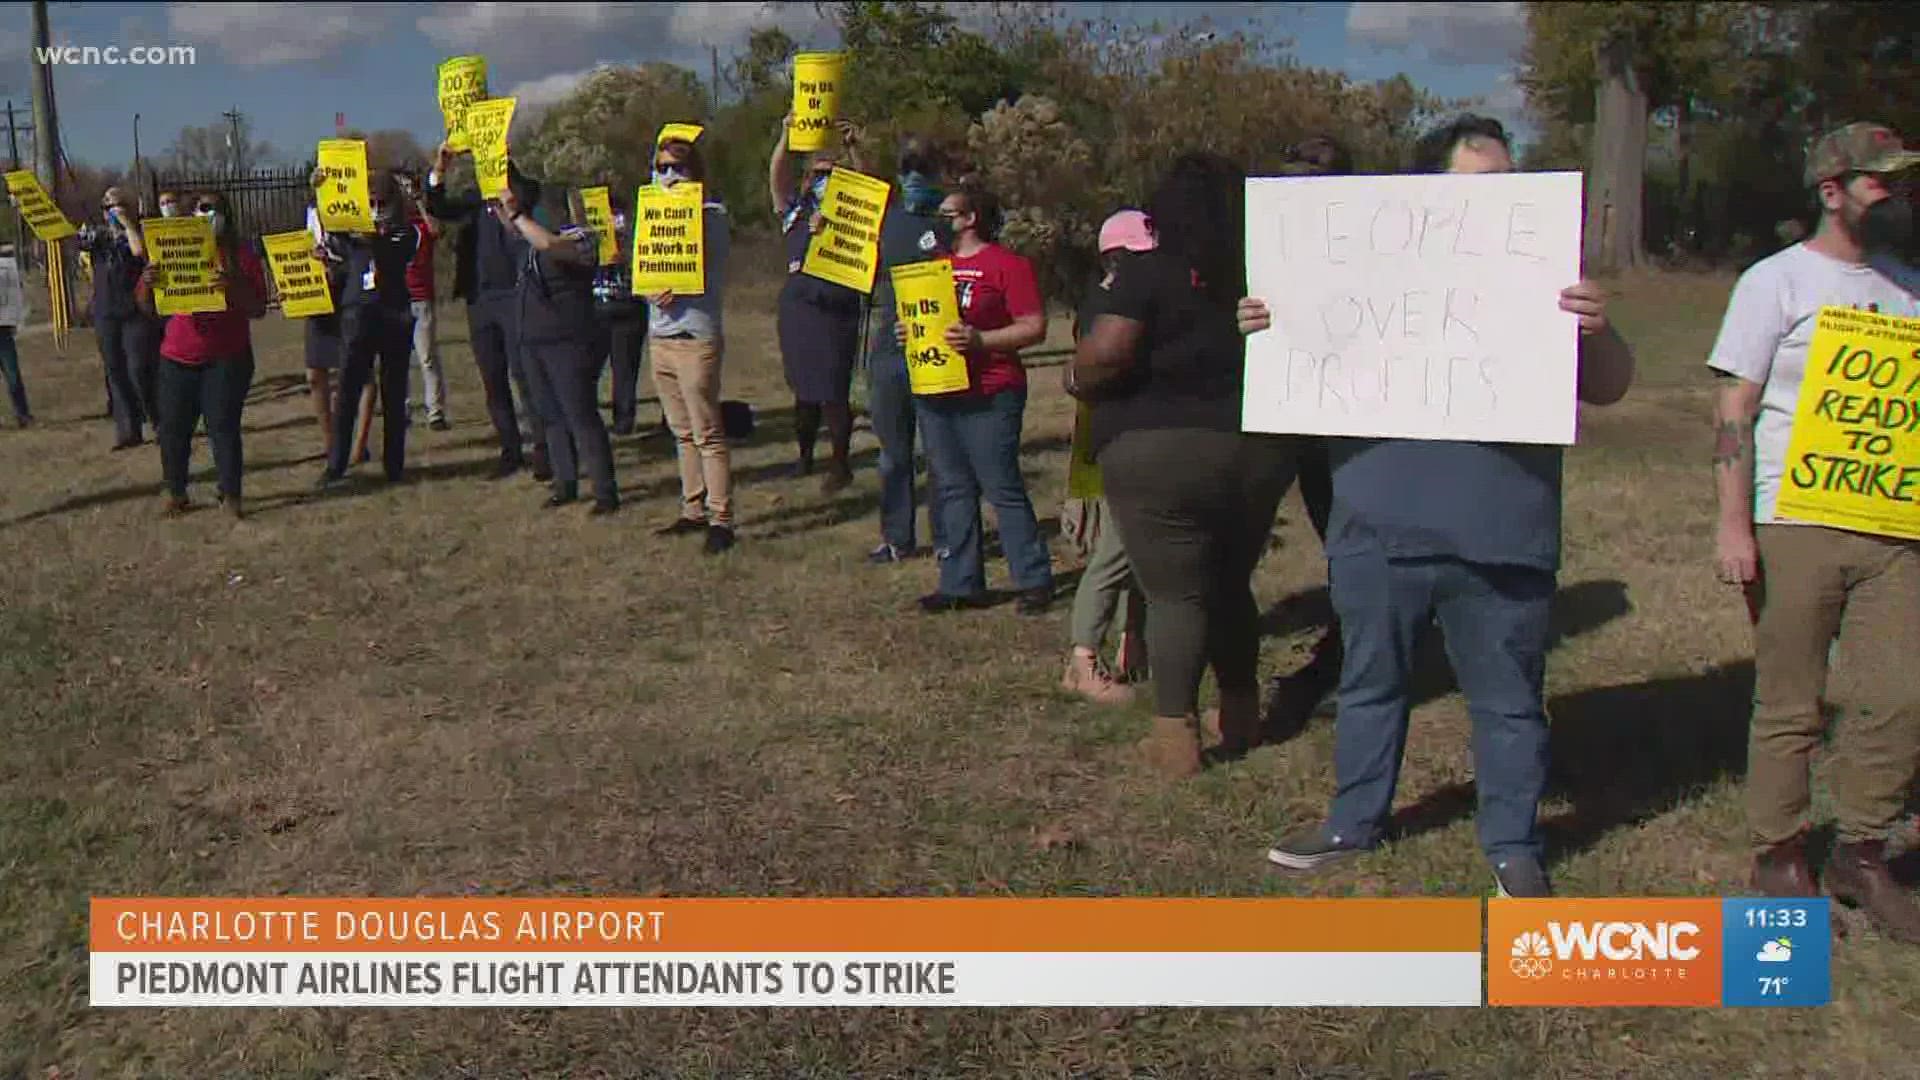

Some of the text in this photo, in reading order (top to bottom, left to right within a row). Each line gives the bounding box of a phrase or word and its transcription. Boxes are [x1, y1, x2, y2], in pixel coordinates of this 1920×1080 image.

[799, 82, 815, 95] Pay
[808, 98, 820, 109] Or
[325, 167, 342, 179] Pay
[338, 182, 348, 193] Or
[645, 206, 693, 220] We Can't
[650, 225, 686, 238] Afford
[651, 242, 684, 255] Work
[686, 243, 699, 255] at
[639, 260, 698, 273] Piedmont
[920, 299, 940, 315] Us
[1320, 287, 1480, 344] OVER
[911, 323, 926, 339] Or
[1843, 431, 1892, 456] TO
[1792, 453, 1920, 502] STRIKE
